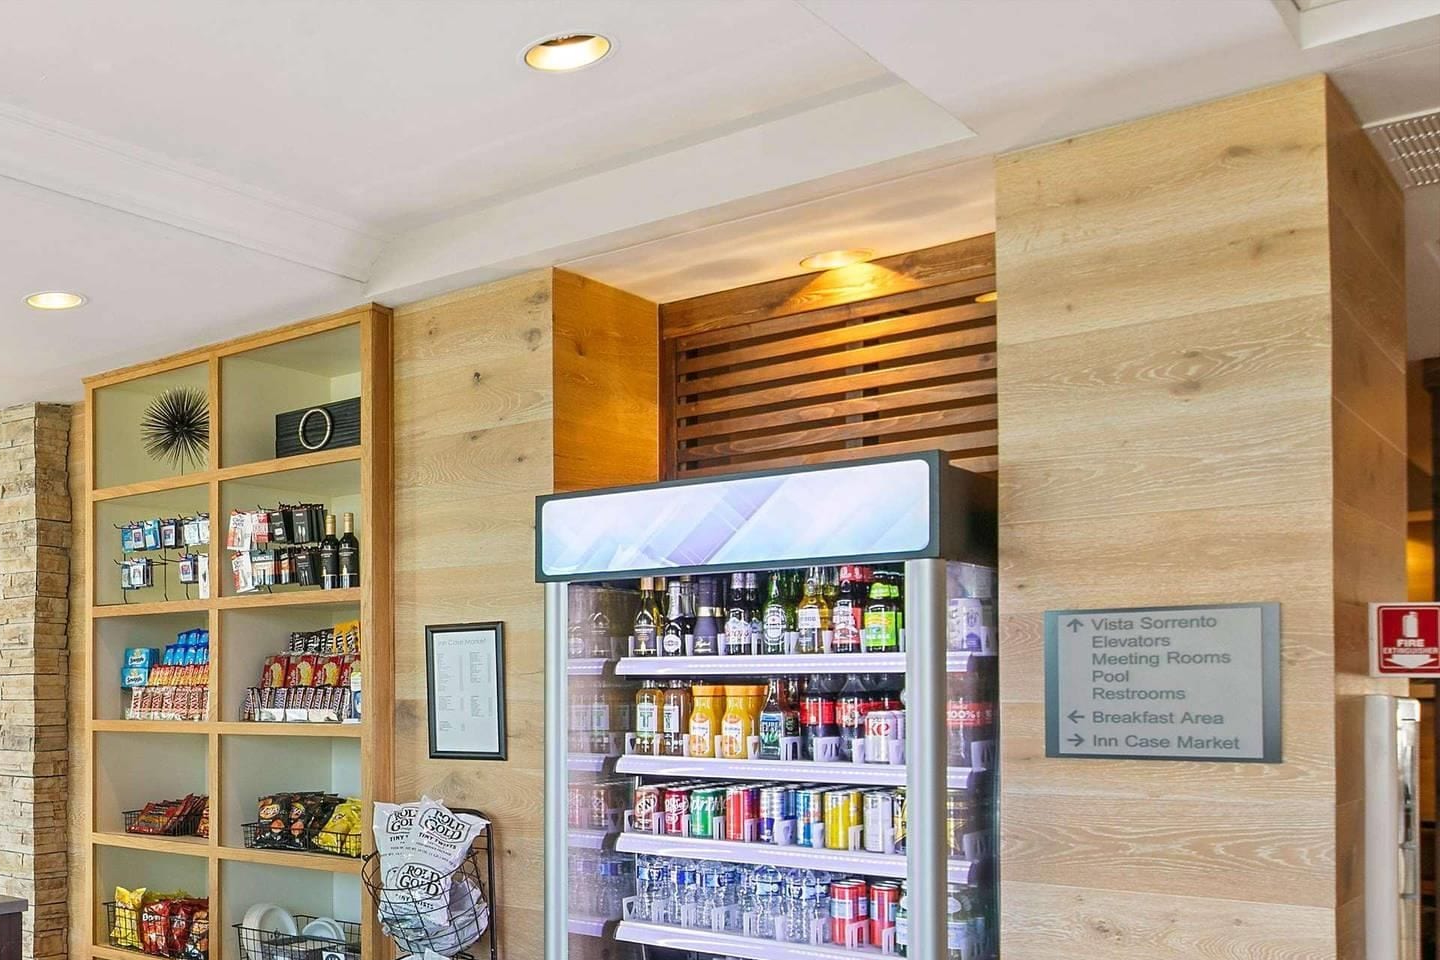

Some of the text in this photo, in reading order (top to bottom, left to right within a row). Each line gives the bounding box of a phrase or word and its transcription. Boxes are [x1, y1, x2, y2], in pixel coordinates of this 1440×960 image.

[1091, 615, 1217, 632] Vista Sorrento
[1092, 635, 1171, 649] Elevators
[1396, 638, 1425, 648] FIRE
[1092, 650, 1231, 668] Meeting Rooms
[1092, 669, 1129, 684] Pool
[1092, 687, 1186, 701] Restrooms
[1092, 710, 1225, 726] Breakfast Area
[1093, 735, 1241, 751] Inn Case Market
[394, 808, 418, 820] ROL
[434, 810, 465, 831] ROLD
[424, 818, 463, 841] GOLD
[406, 865, 441, 882] ROLD
[400, 875, 439, 897] GOLD
